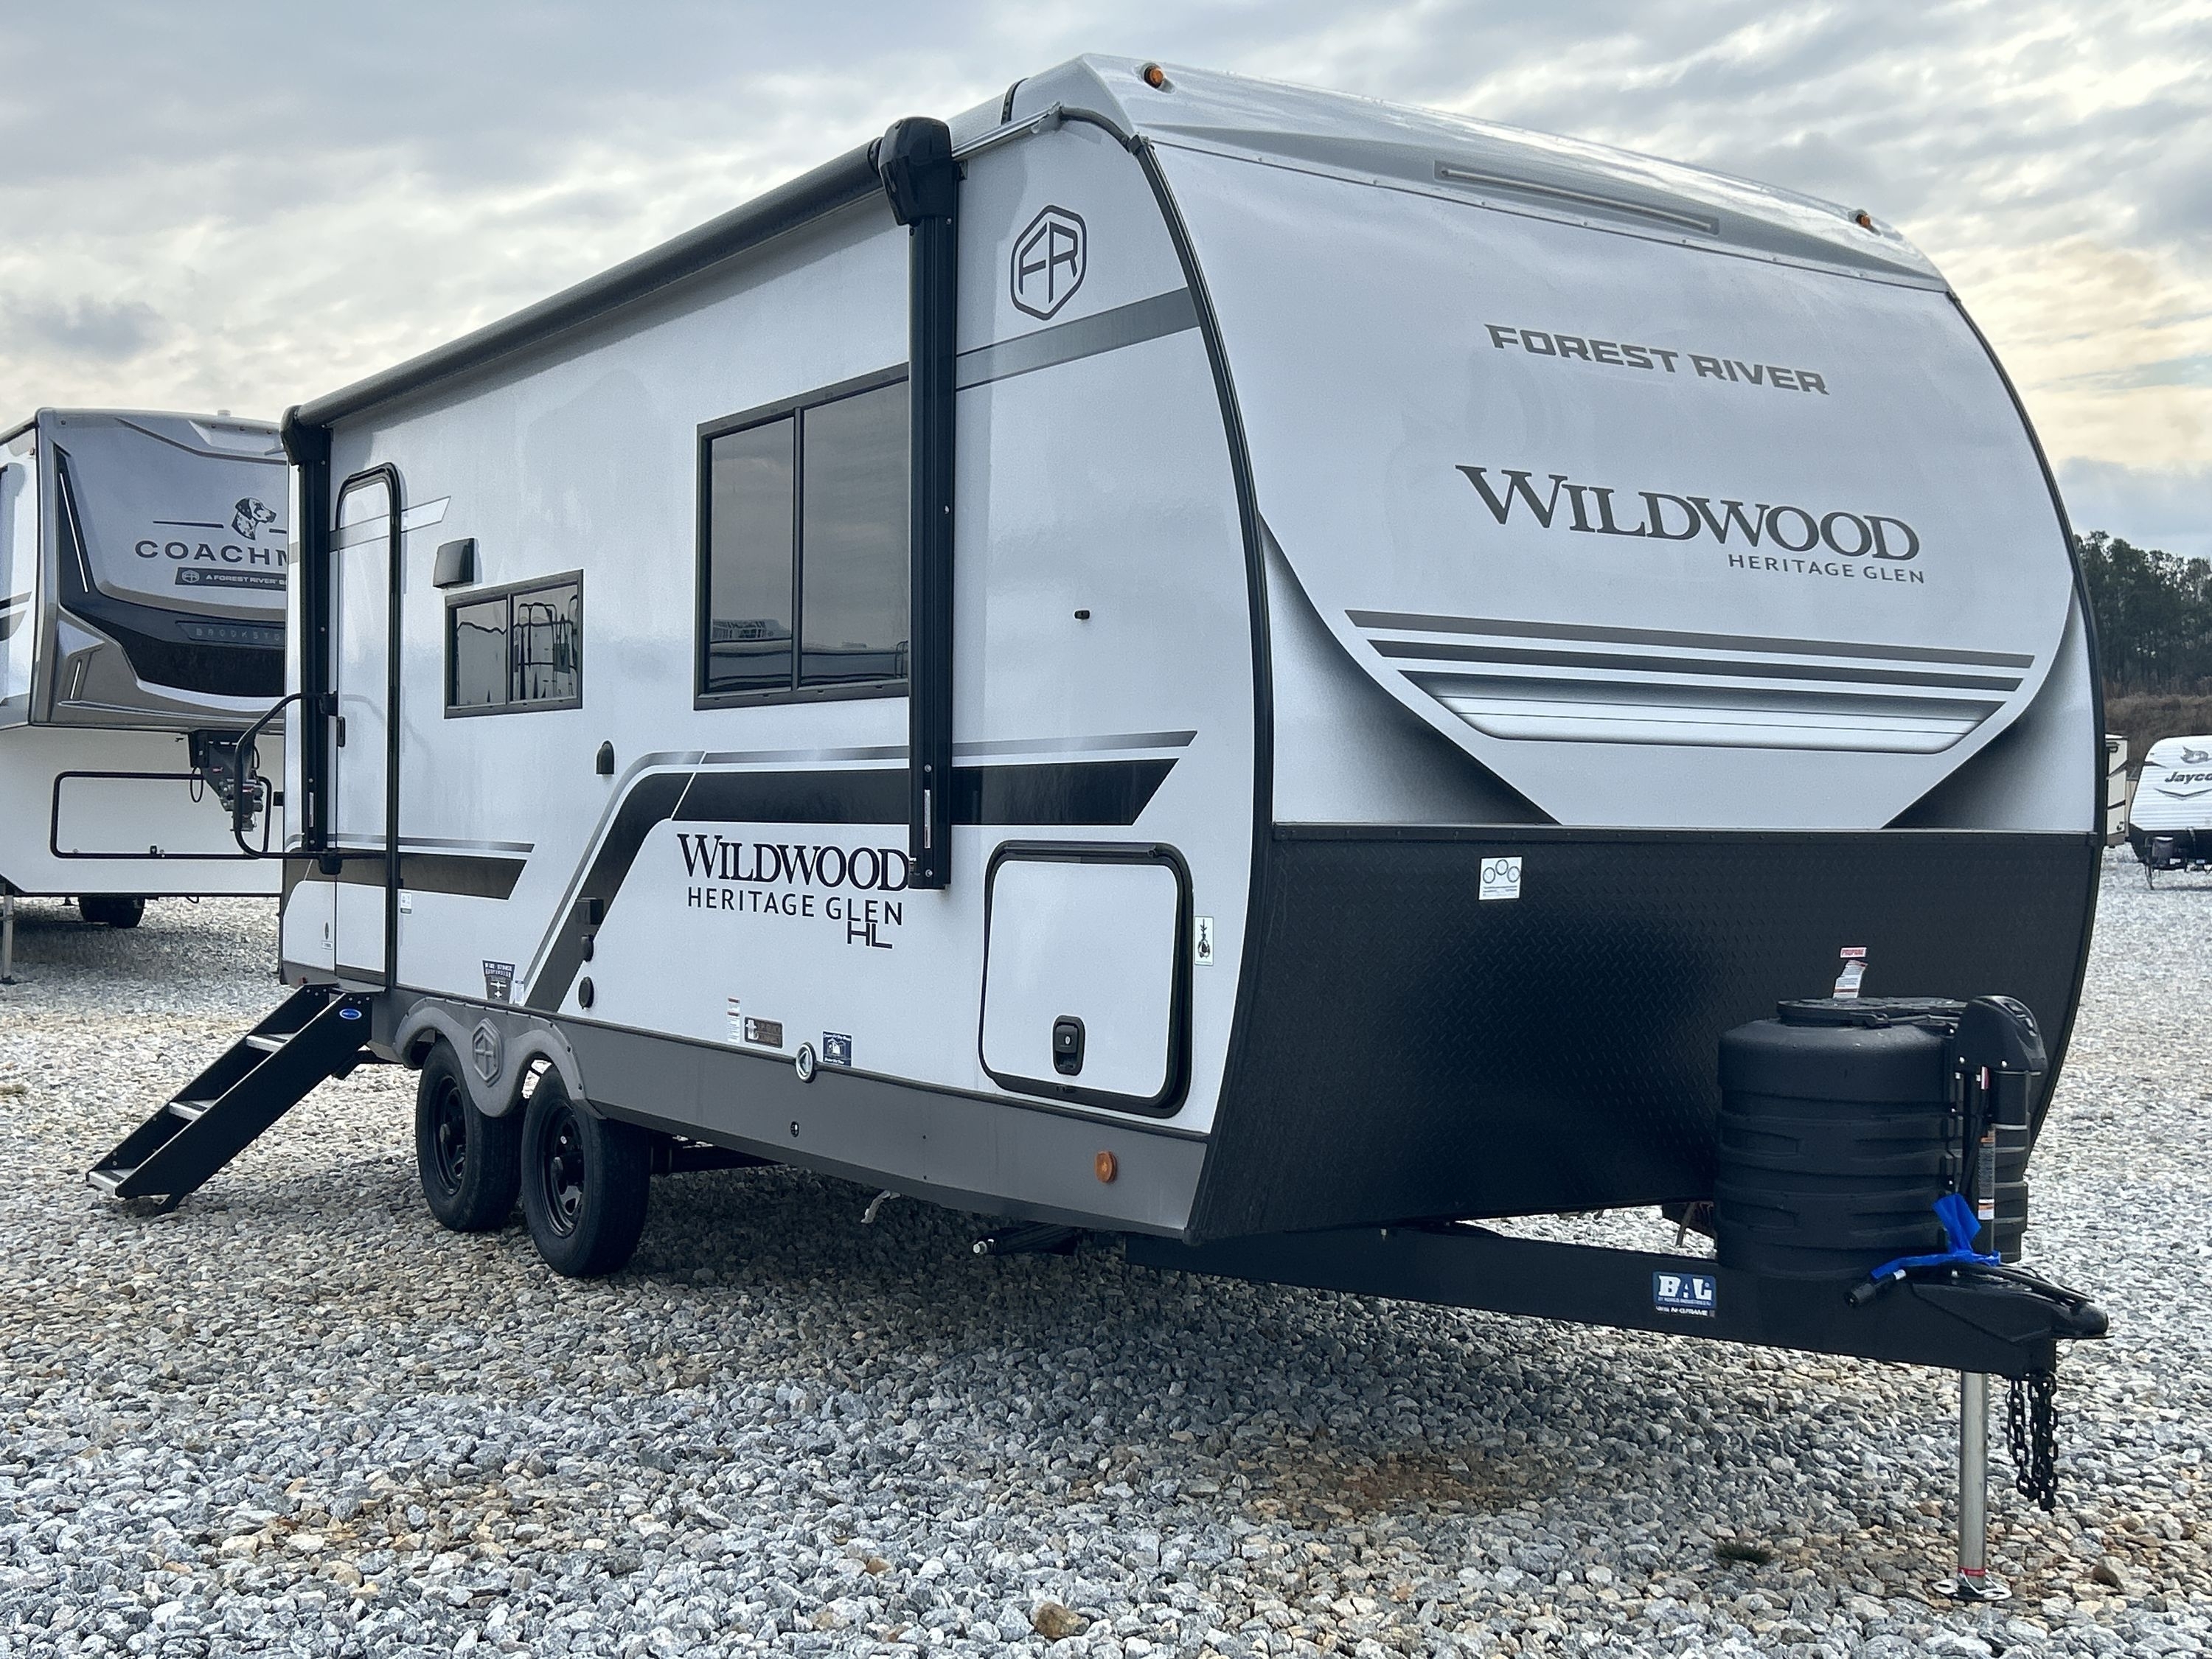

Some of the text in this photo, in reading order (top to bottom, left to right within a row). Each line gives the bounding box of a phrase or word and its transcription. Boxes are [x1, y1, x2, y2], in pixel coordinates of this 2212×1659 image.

[1484, 323, 1830, 396] FOREST RIVER
[214, 574, 248, 582] FOREST
[1728, 553, 1925, 585] HERITAGE GLEN
[687, 886, 902, 926] HERITAGE GLEN
[846, 921, 893, 949] HL
